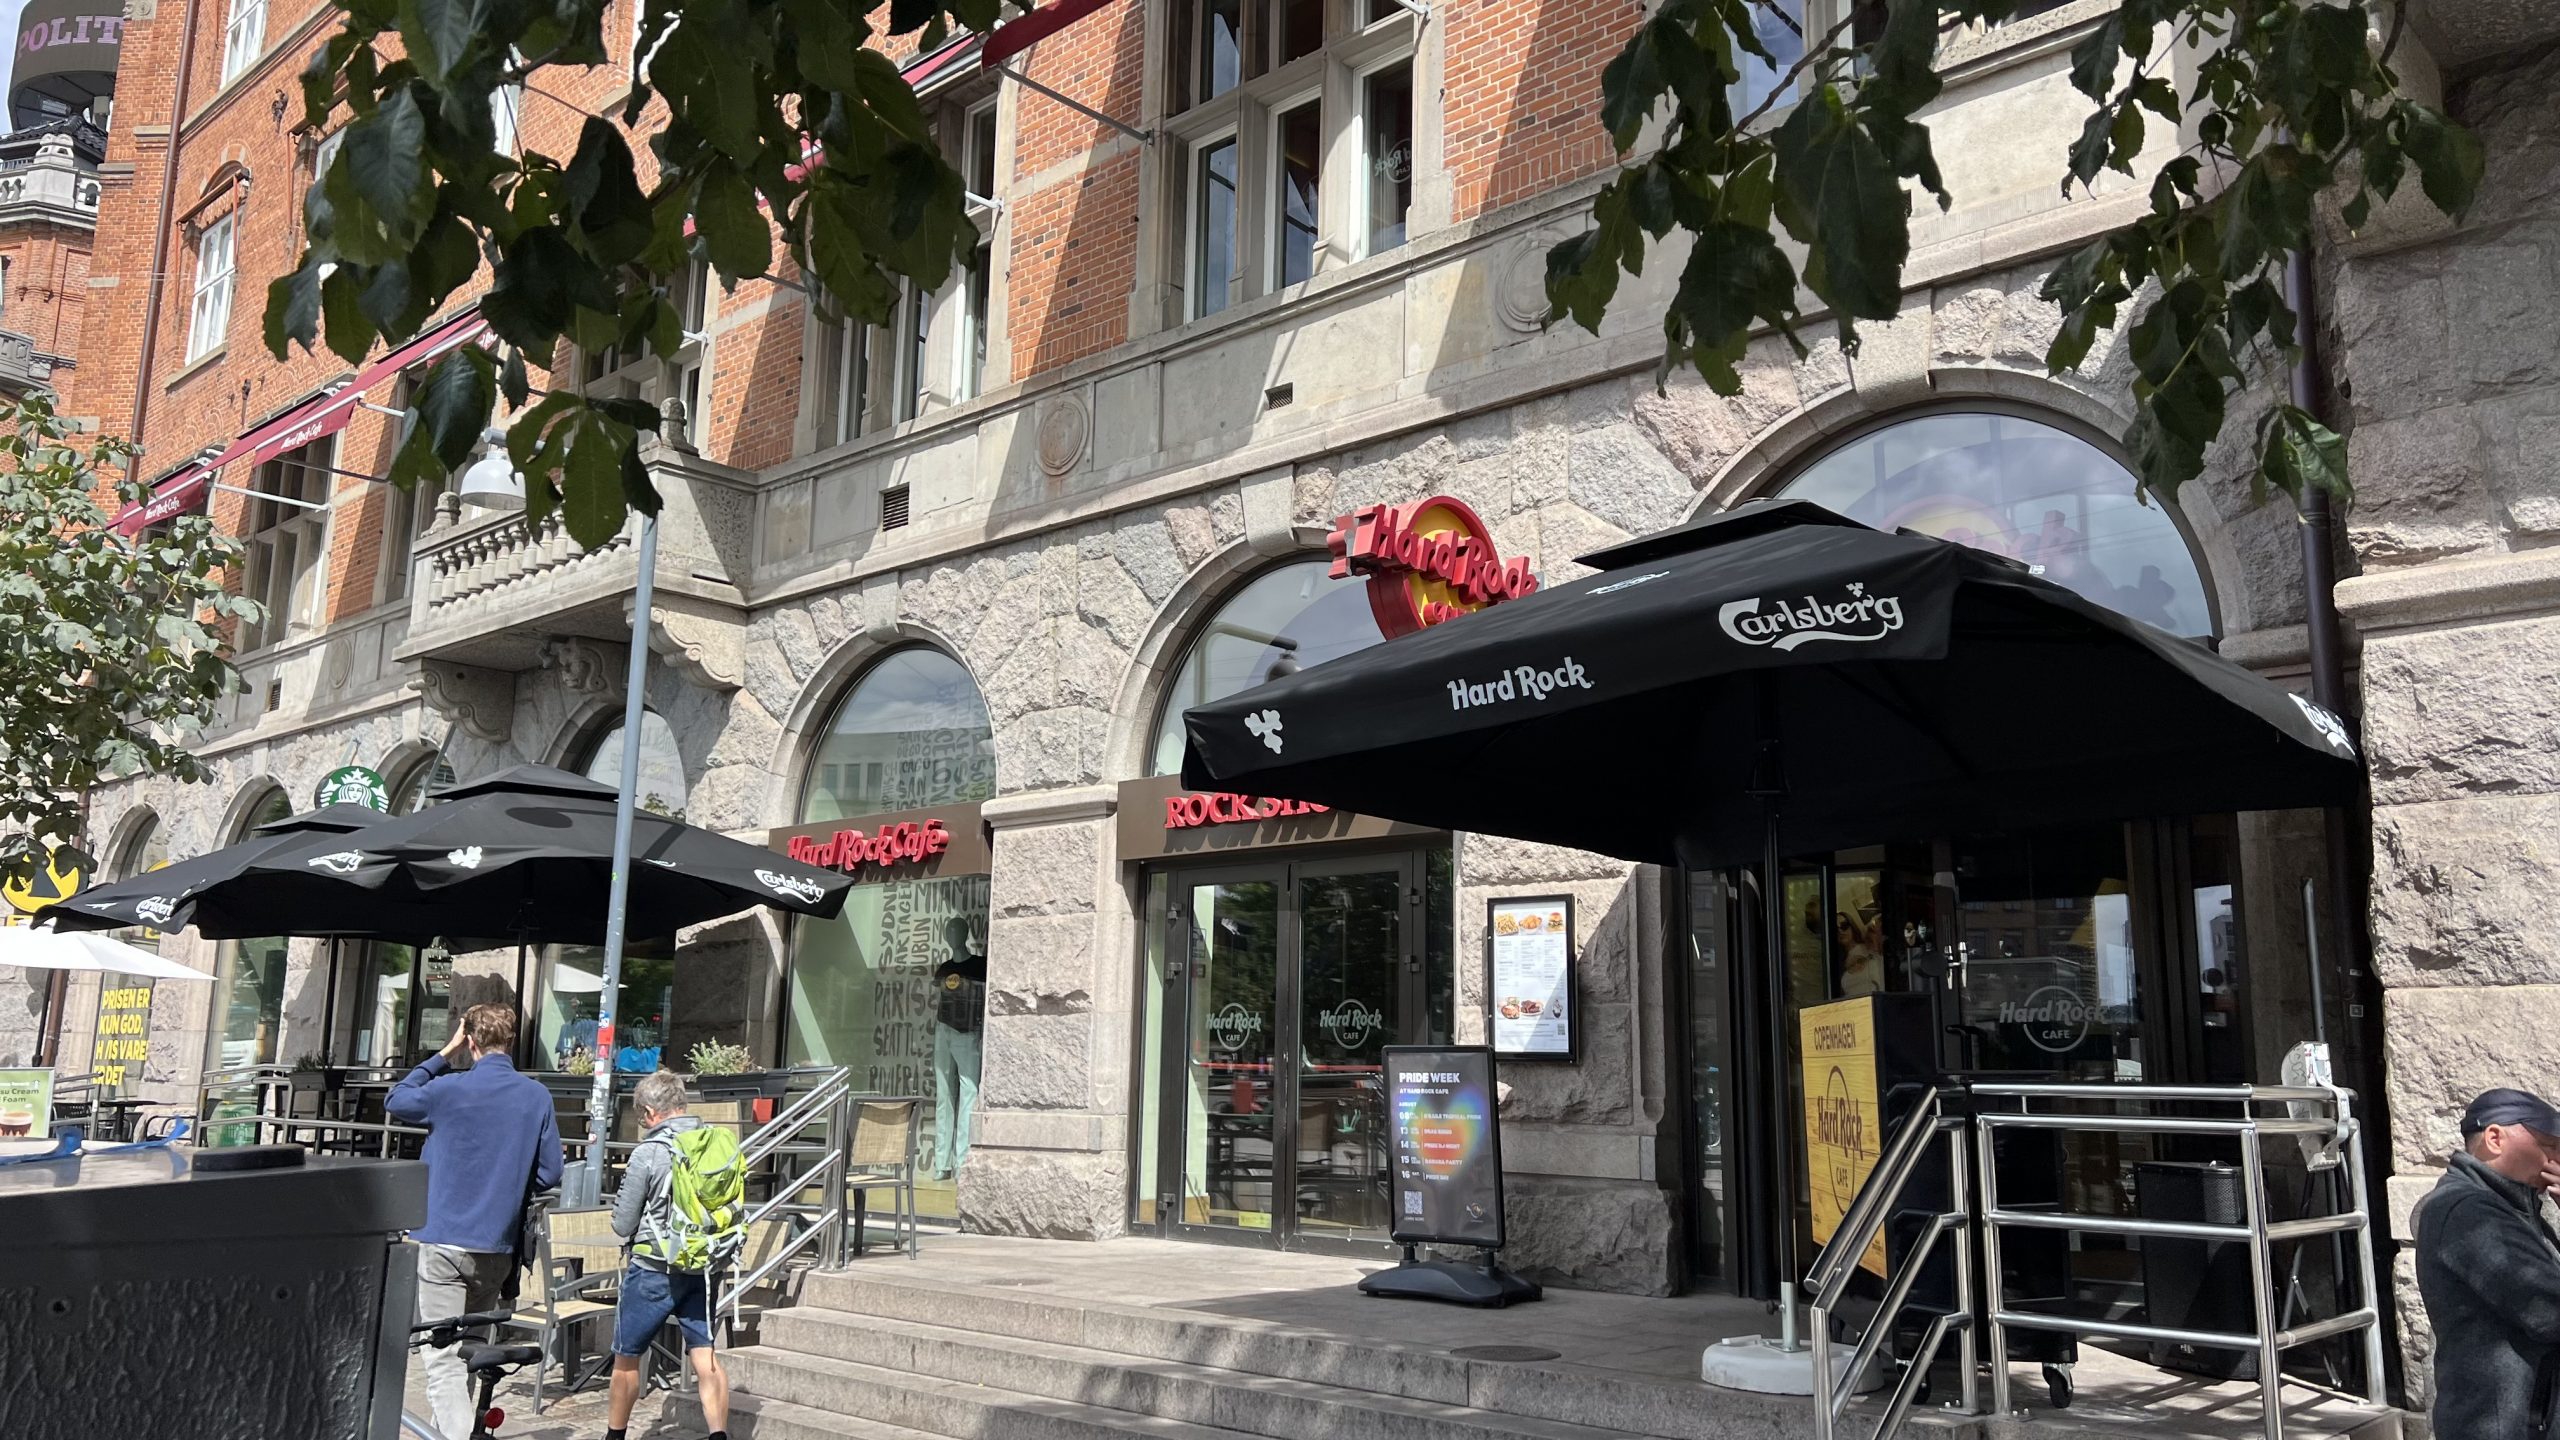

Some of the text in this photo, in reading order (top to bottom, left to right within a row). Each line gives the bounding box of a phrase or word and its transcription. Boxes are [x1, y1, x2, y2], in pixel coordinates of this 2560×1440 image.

[1328, 504, 1539, 603] Hard Rock
[1718, 594, 1904, 652] Carlsberg
[1447, 656, 1593, 710] Hard Rock
[896, 775, 926, 799] SAN
[1164, 792, 1262, 829] ROCK
[787, 818, 949, 871] Hard Rock Cafe
[754, 869, 825, 904] Carlsberg
[135, 896, 177, 923] Carlsber
[102, 987, 151, 1009] PRISEN ER
[874, 977, 926, 1019] PARIS
[1206, 1011, 1262, 1032] Hard Rock
[1319, 1008, 1382, 1030] Hard Rock
[2000, 1000, 2053, 1024] Hard
[99, 1014, 144, 1038] KUN GOD,
[1226, 1034, 1241, 1042] CAFE
[1343, 1031, 1359, 1040] CAFE
[1813, 1022, 1856, 1051] COPENHAGEN
[2042, 1030, 2070, 1039] CAFE
[105, 1065, 125, 1086] DET
[1399, 1072, 1460, 1083] PRIDE WEEK
[1817, 1096, 1863, 1161] Hard Rock
[1400, 1140, 1409, 1149] 14
[1401, 1155, 1410, 1164] 15
[1401, 1170, 1411, 1179] 16
[1836, 1167, 1848, 1189] CAFE
